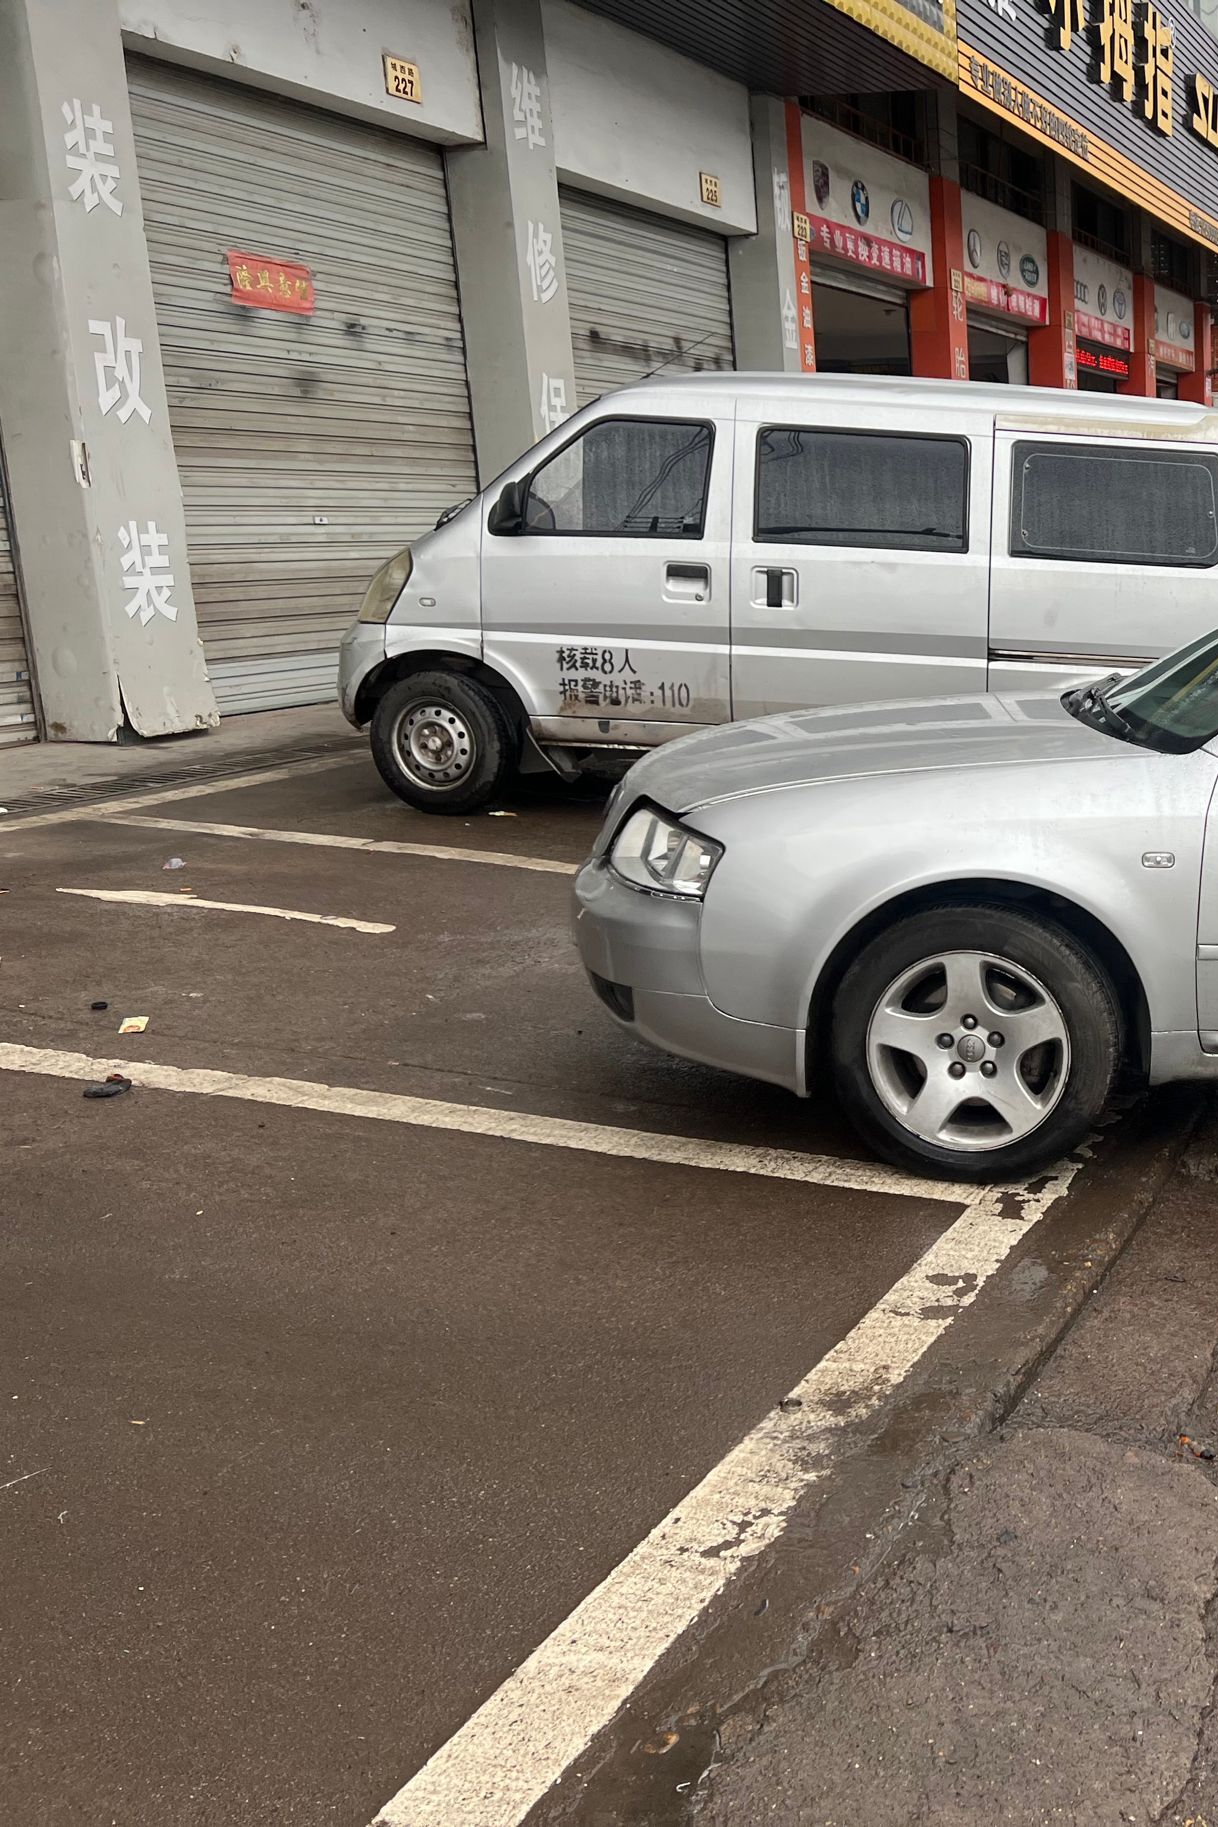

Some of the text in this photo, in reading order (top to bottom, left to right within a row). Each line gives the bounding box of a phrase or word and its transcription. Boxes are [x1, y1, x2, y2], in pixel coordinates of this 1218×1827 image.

[394, 75, 414, 97] 227
[706, 187, 718, 203] 225
[820, 224, 912, 275] 专业更换变速箱油
[952, 291, 967, 379] 轮胎
[556, 646, 637, 675] 核载8人
